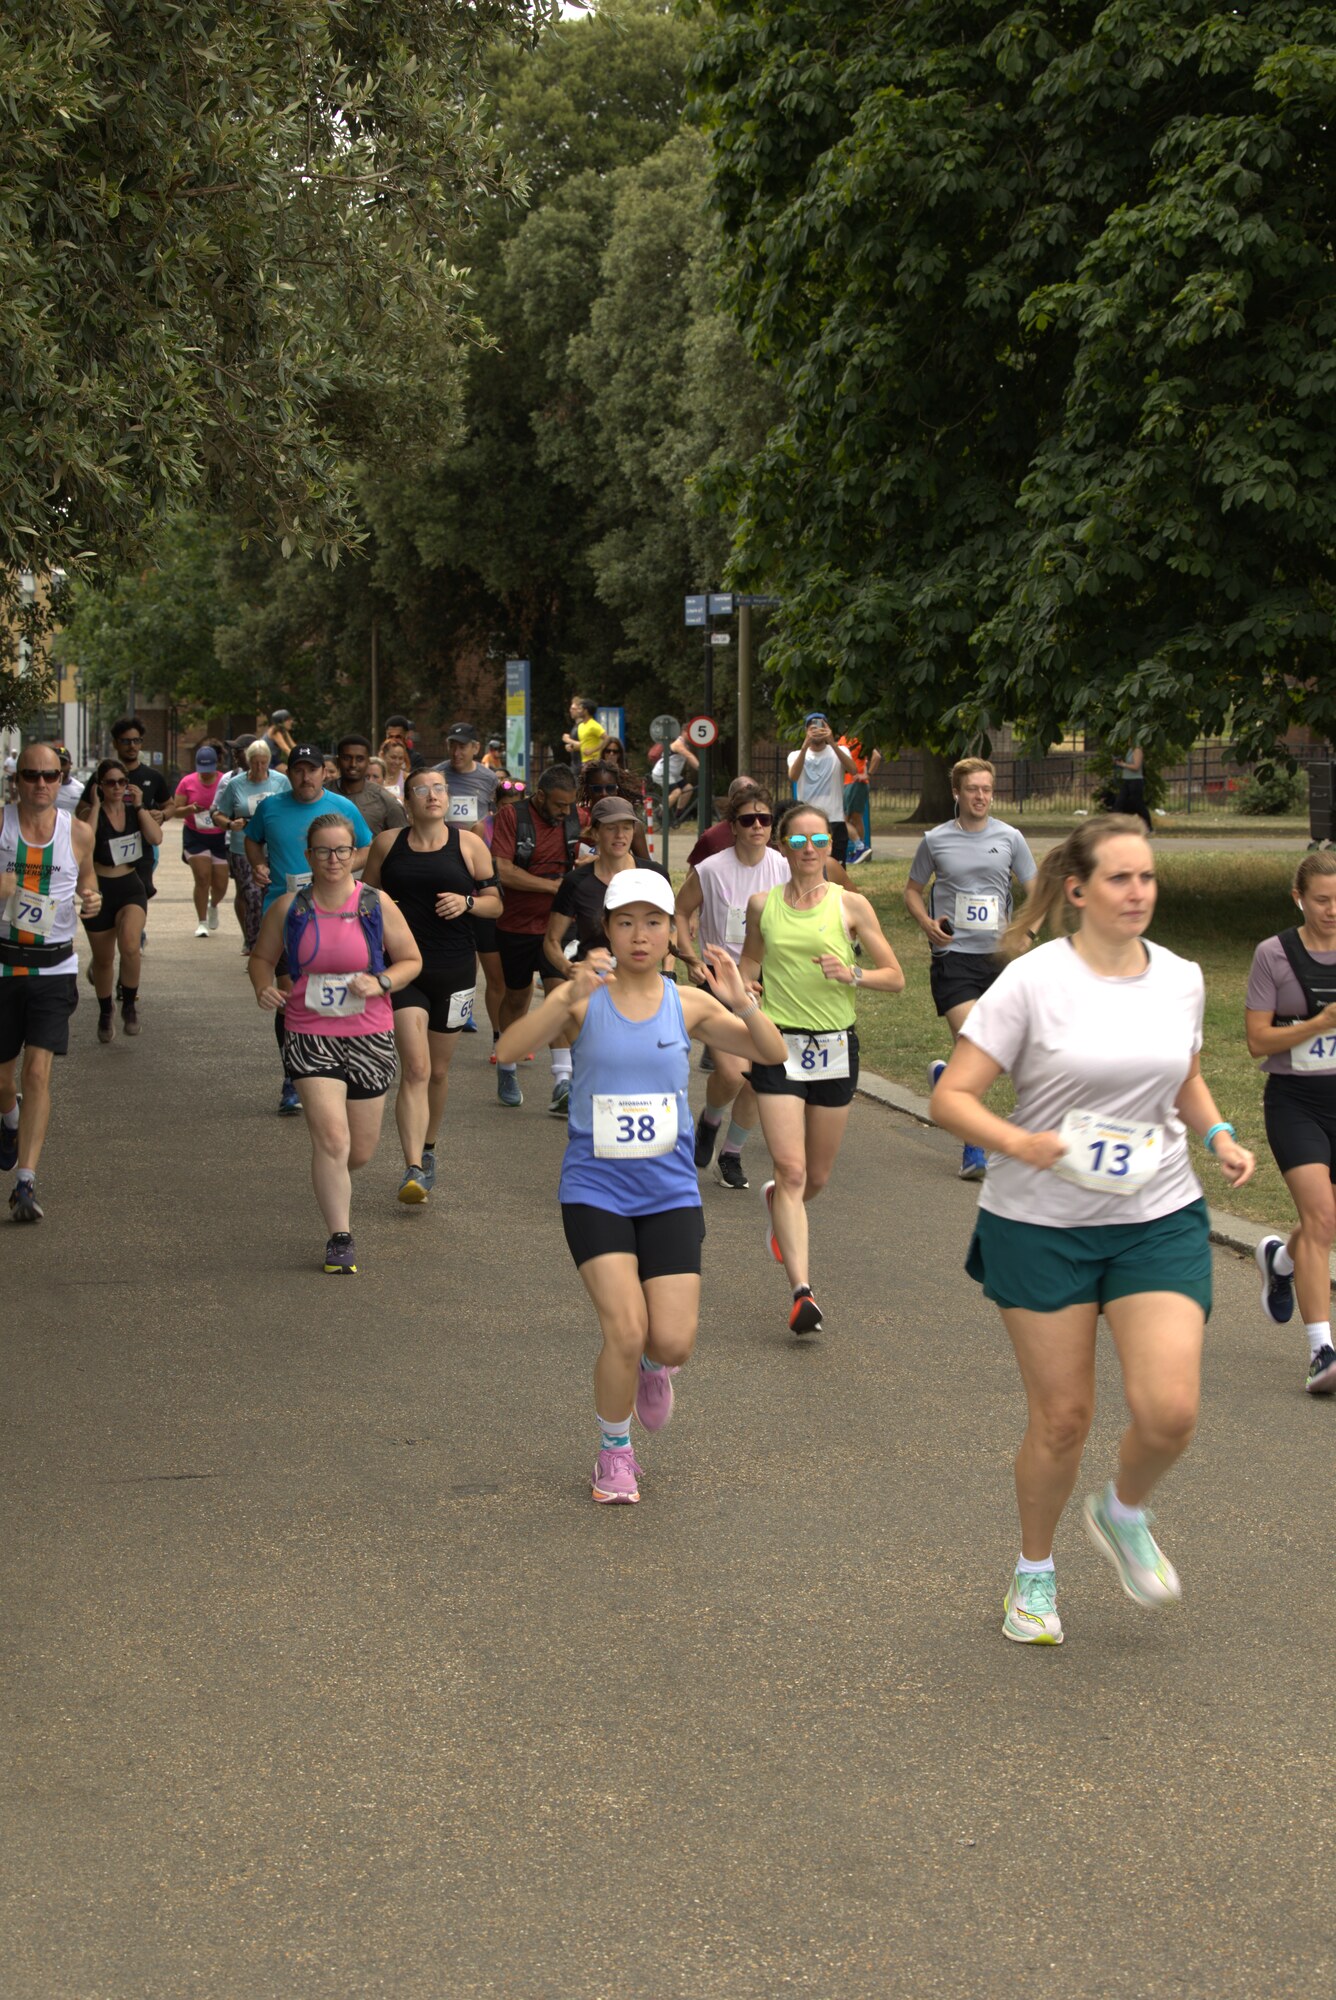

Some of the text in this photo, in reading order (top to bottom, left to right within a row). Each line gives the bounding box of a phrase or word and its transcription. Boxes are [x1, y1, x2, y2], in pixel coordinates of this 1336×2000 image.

[698, 725, 707, 738] 5
[453, 803, 468, 816] 26
[120, 842, 136, 857] 77
[17, 902, 43, 923] 79
[966, 906, 988, 921] 50
[321, 987, 347, 1007] 37
[1309, 1036, 1336, 1058] 47
[801, 1048, 828, 1070] 81
[616, 1115, 656, 1142] 38
[1088, 1140, 1132, 1176] 13
